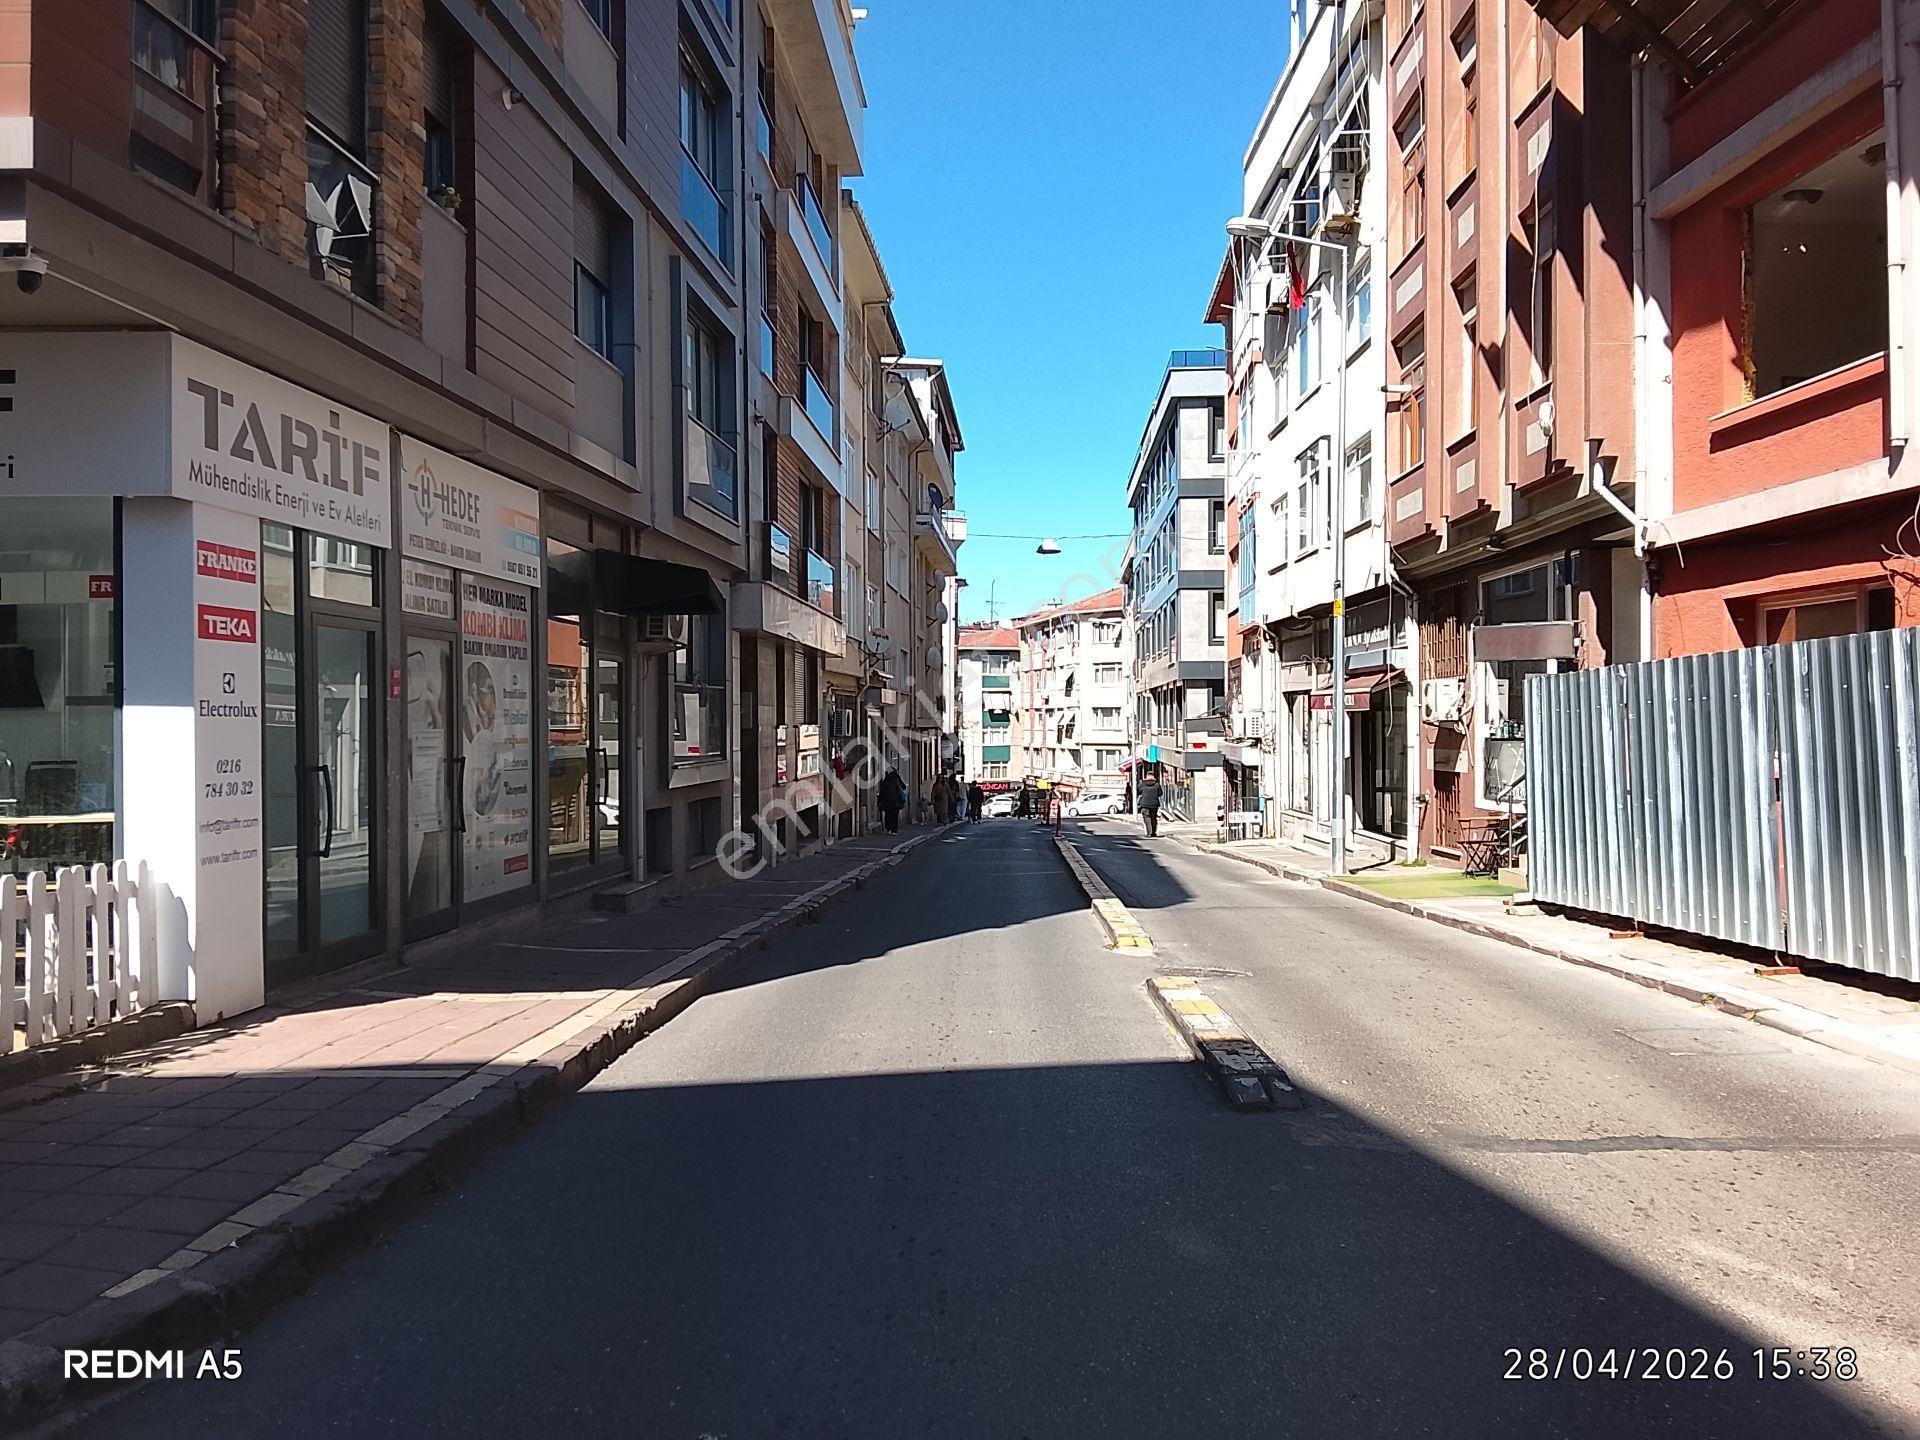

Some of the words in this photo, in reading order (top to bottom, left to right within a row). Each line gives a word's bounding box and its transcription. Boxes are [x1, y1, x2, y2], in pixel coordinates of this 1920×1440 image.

[187, 378, 380, 497] TARİF
[188, 459, 271, 503] Mühendislik
[275, 485, 309, 518] Enerji
[312, 500, 325, 517] ve
[329, 500, 341, 520] Ev
[345, 505, 381, 532] Aletleri
[441, 482, 480, 524] HEDEF
[198, 549, 256, 576] FRANKE
[203, 614, 251, 638] TEKA
[199, 699, 258, 717] Electrolux
[216, 759, 241, 774] 0216
[205, 783, 223, 798] 784
[226, 782, 239, 797] 30
[241, 781, 253, 795] 32
